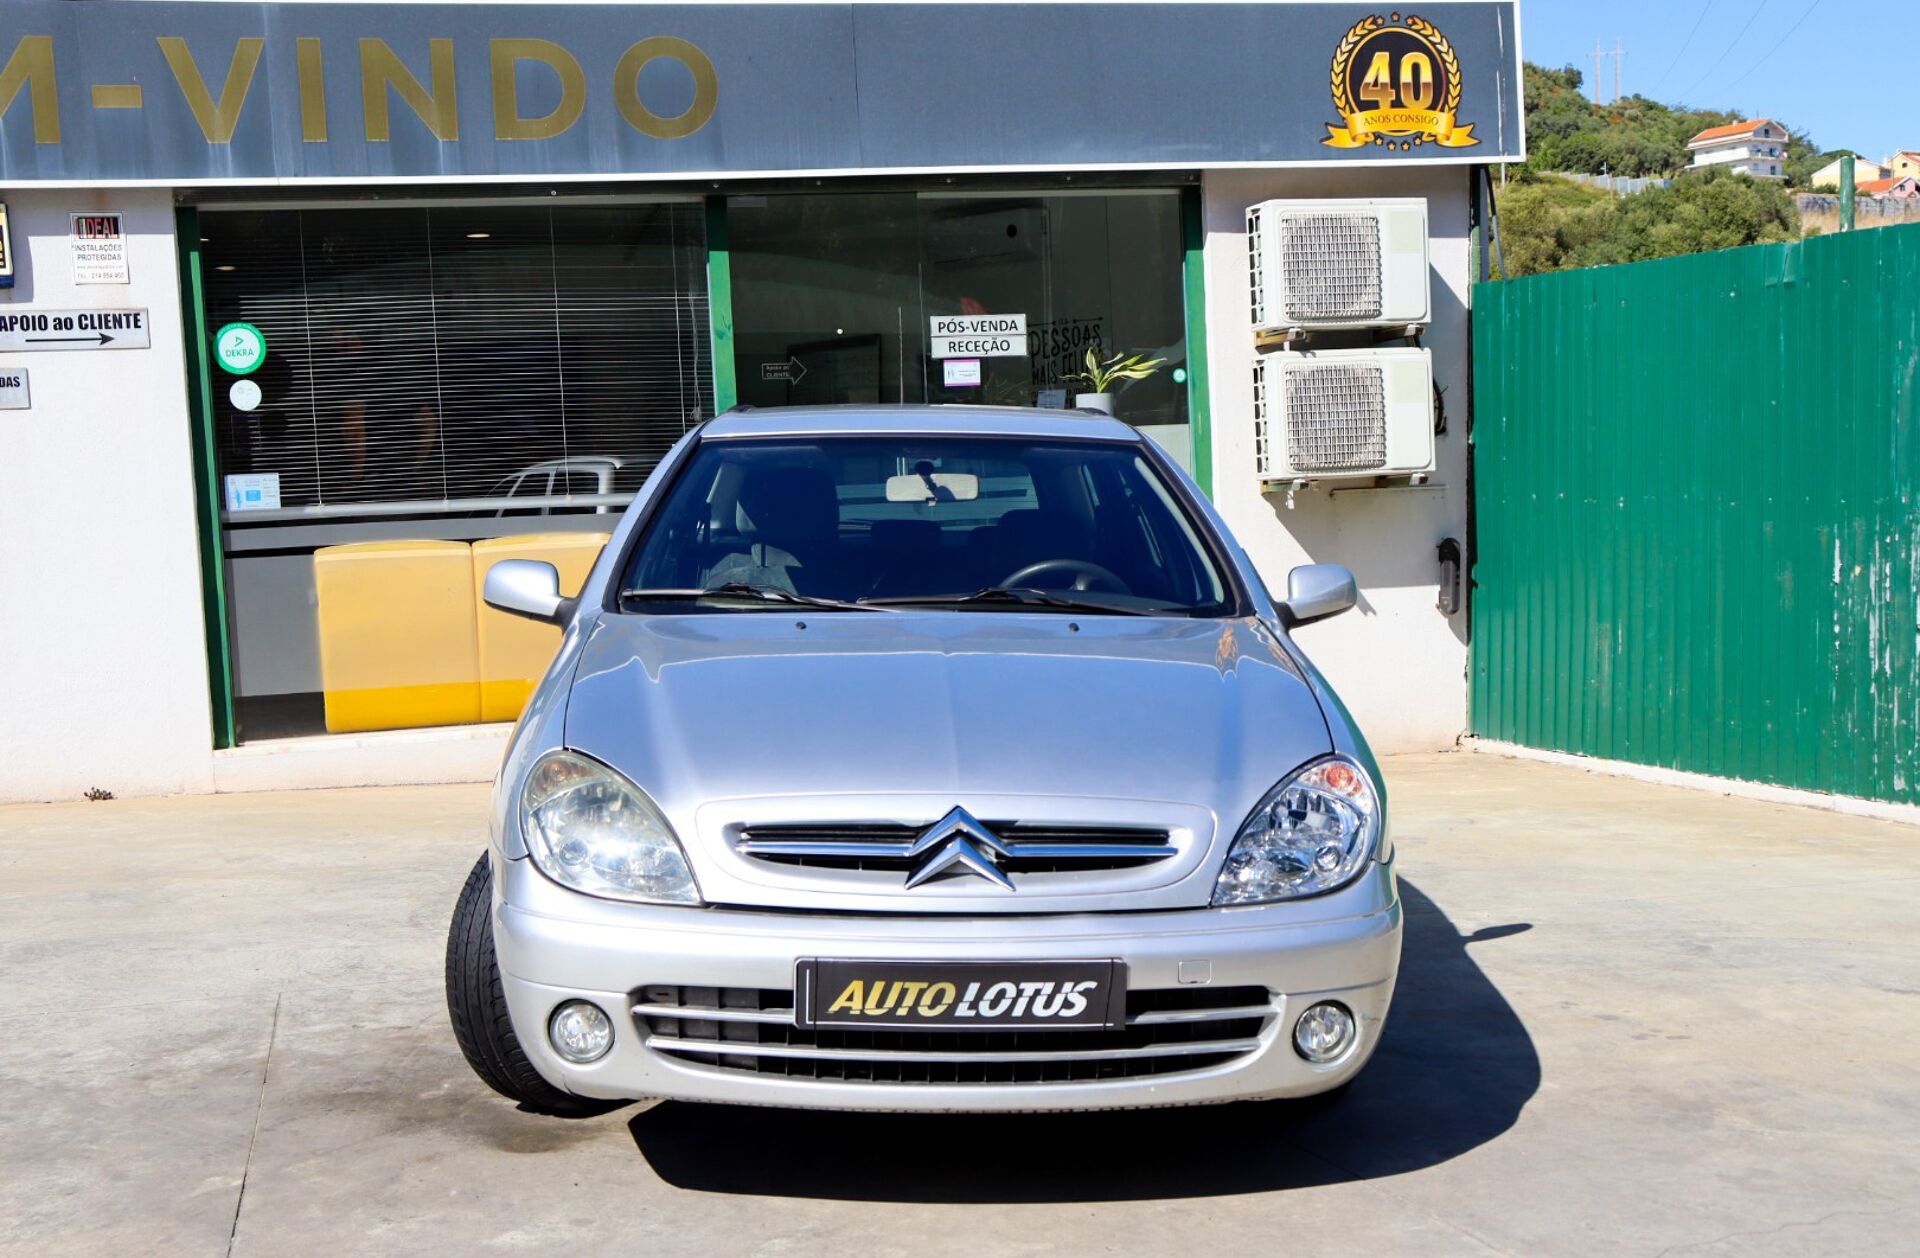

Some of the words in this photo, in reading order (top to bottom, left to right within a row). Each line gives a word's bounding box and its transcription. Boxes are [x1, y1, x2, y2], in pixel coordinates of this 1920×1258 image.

[1360, 51, 1434, 110] 40
[1363, 115, 1391, 126] ANOS
[1393, 114, 1439, 125] CONSIGO
[77, 253, 122, 261] PROTEGIDAS
[0, 315, 48, 332] APOIO
[53, 317, 73, 330] ao
[78, 313, 142, 330] CLIENTE
[938, 318, 1018, 333] PÓS-VENDA
[225, 348, 254, 357] DEKRA
[948, 337, 1010, 354] RECEÇÃO
[1028, 324, 1103, 368] PESSOAS
[826, 980, 956, 1017] AUTO
[954, 981, 1098, 1017] LOTUS
